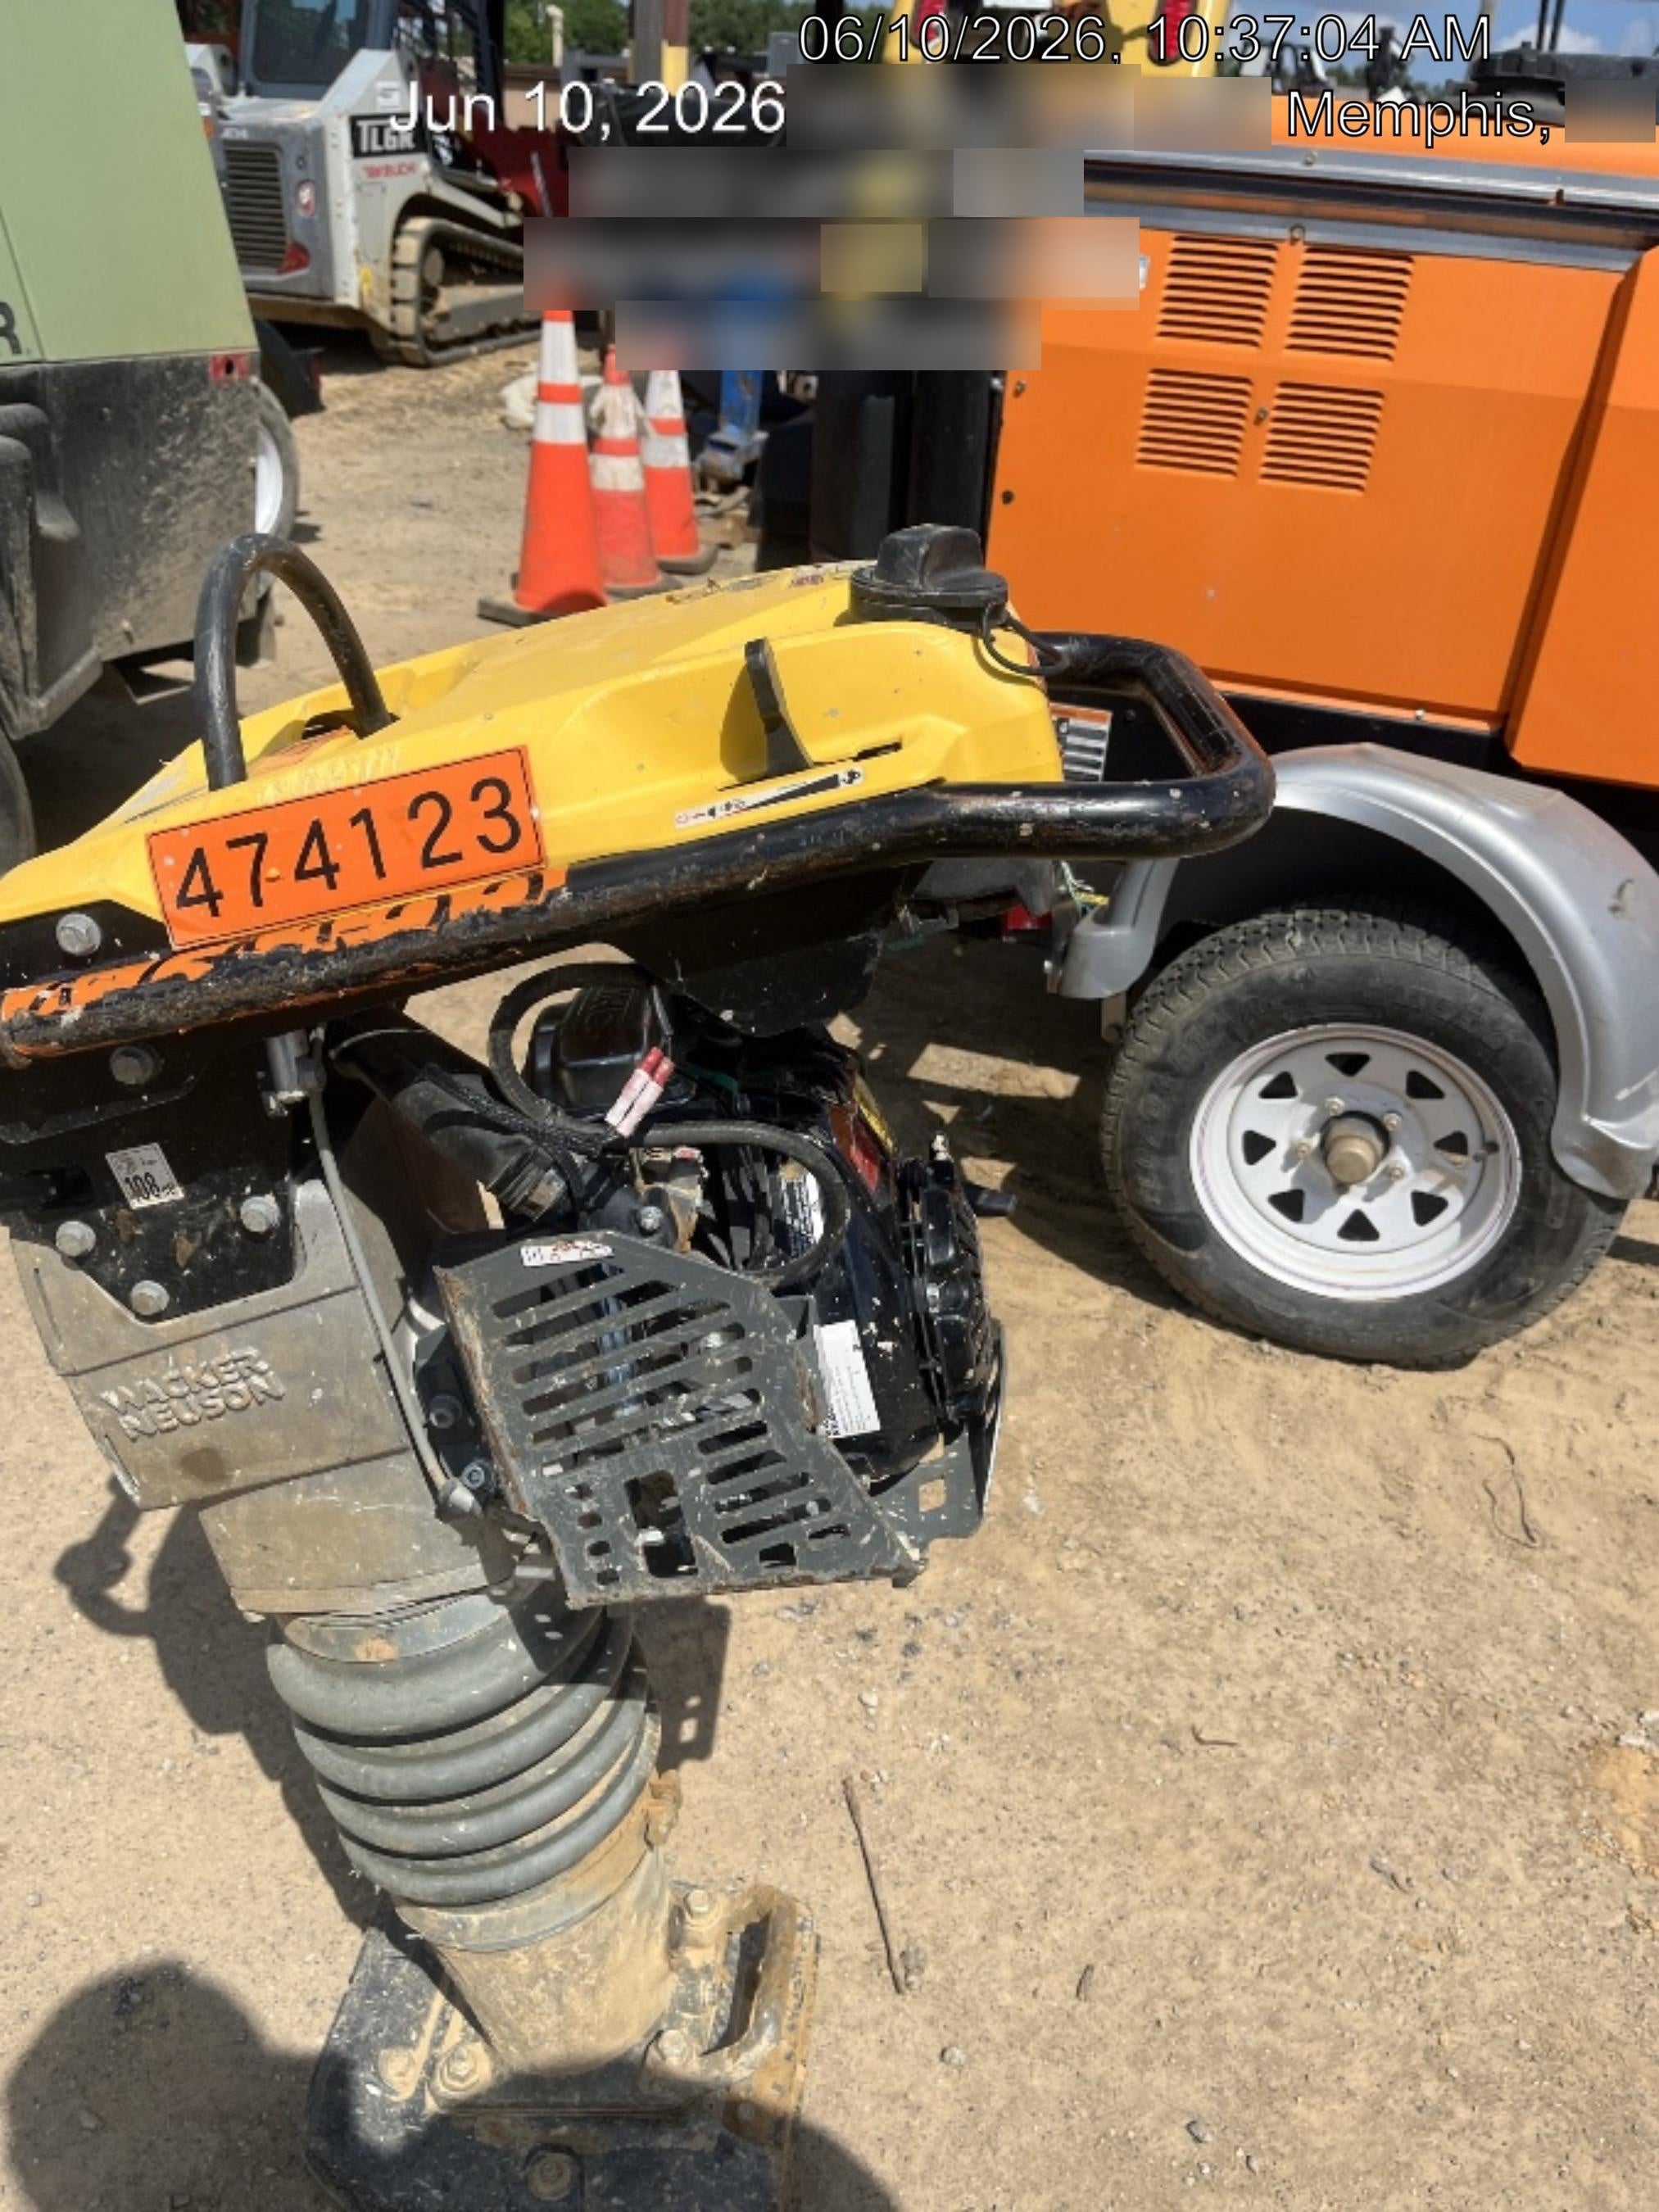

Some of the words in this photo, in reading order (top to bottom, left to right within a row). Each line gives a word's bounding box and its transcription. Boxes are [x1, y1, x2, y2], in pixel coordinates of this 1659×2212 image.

[175, 777, 522, 918] 474123
[100, 1346, 270, 1417] WACKER
[119, 1370, 286, 1442] NEUSON
